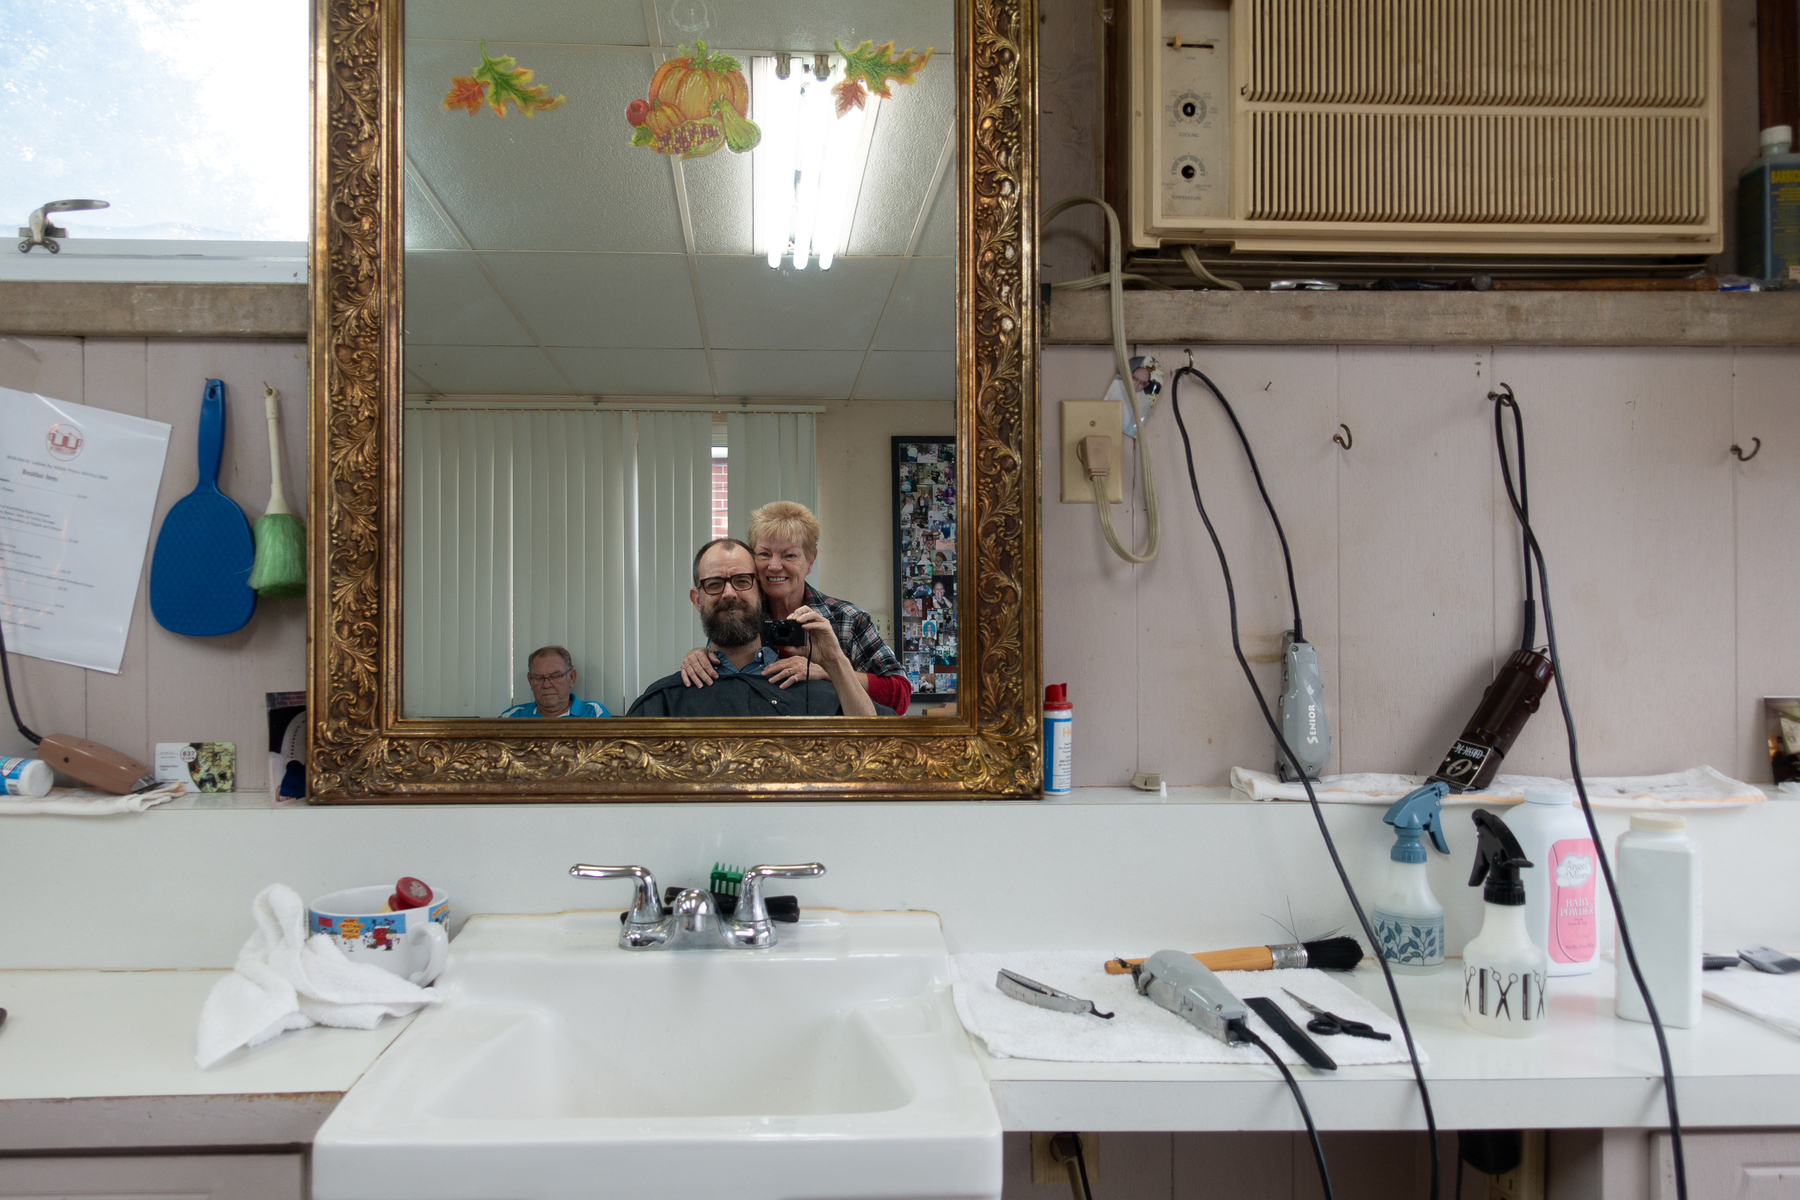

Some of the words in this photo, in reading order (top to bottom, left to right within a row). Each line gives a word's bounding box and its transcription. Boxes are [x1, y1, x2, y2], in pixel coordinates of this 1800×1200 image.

[1306, 704, 1319, 745] SENIOR
[1565, 859, 1588, 872] Angel
[1569, 870, 1587, 879] Mine
[1566, 897, 1590, 908] BABY
[1560, 906, 1594, 917] POWDER
